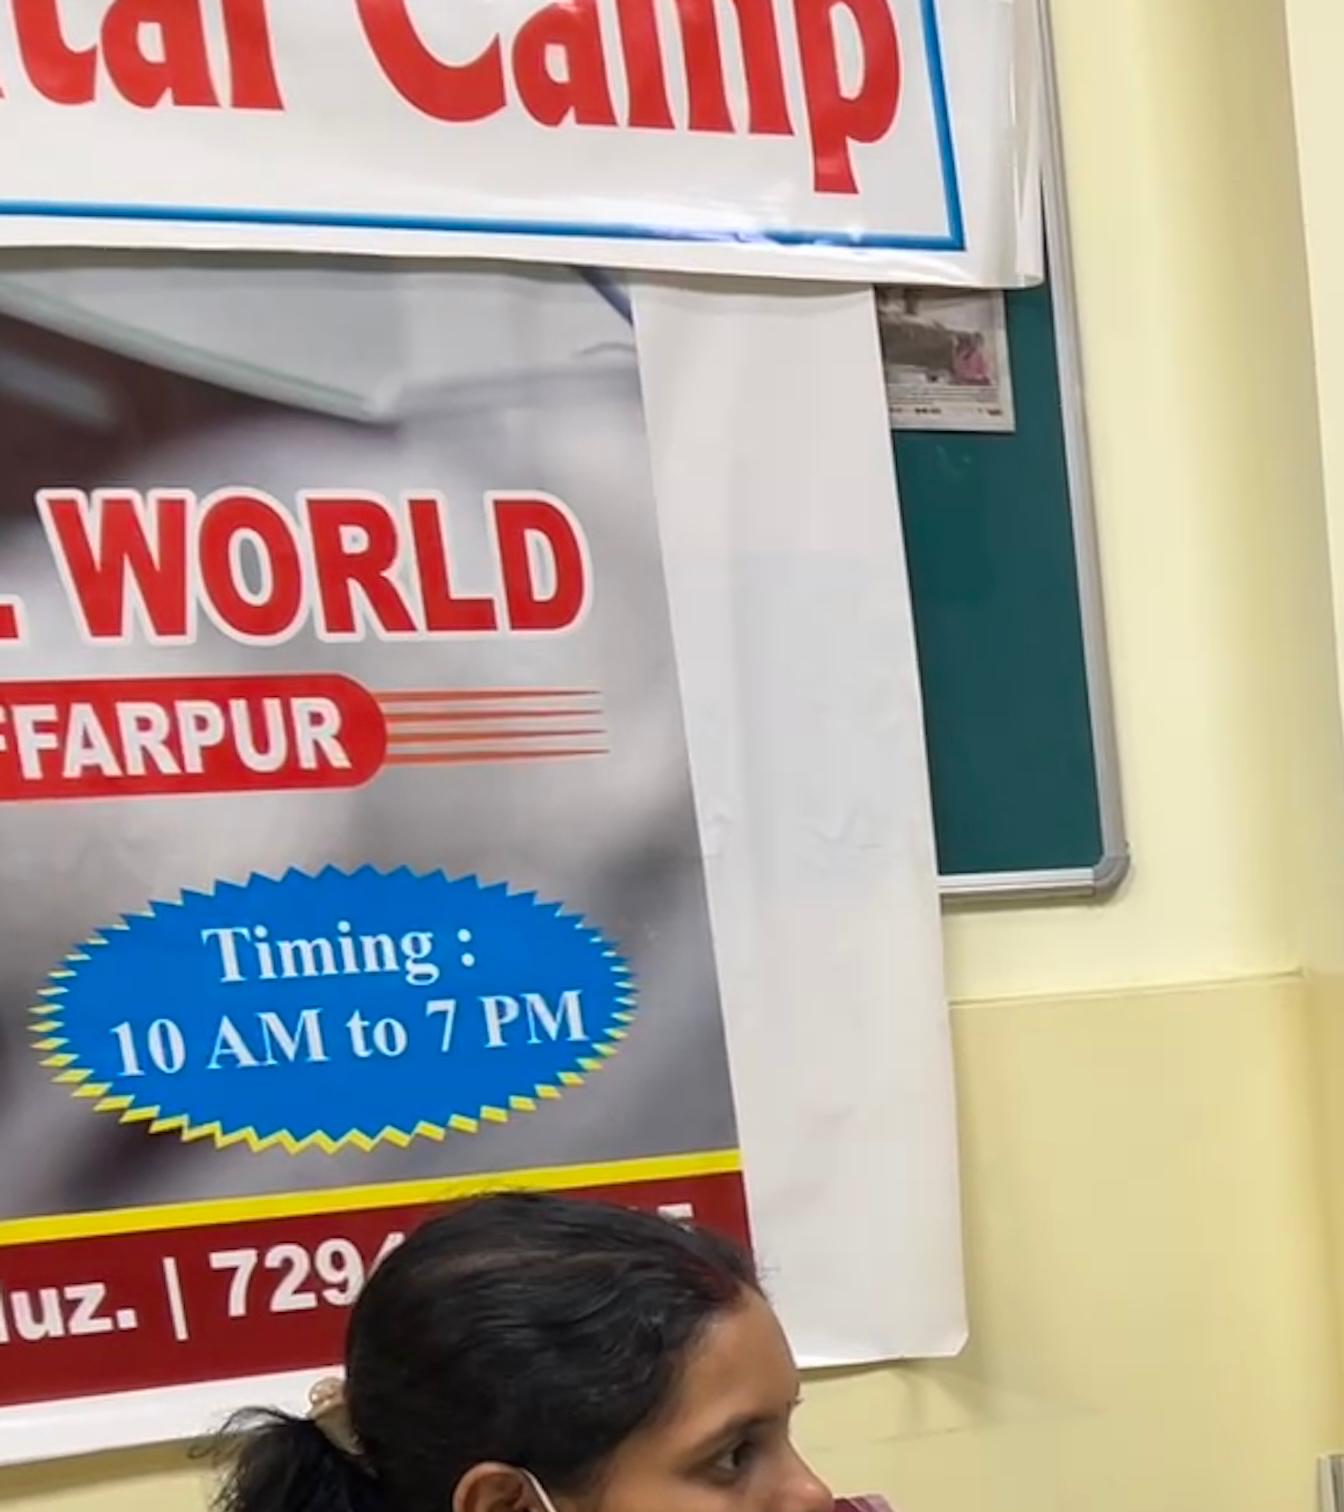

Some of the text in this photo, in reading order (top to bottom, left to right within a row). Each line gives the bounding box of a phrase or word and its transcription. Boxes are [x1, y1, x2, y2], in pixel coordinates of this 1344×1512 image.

[0, 0, 903, 194] tal Camp
[42, 494, 588, 641] WORLD
[0, 696, 352, 779] FARPUR
[202, 920, 441, 986] Timing
[110, 988, 589, 1077] 10 AM to 7 PM
[0, 1281, 137, 1345] uz.
[209, 1235, 402, 1318] 729
